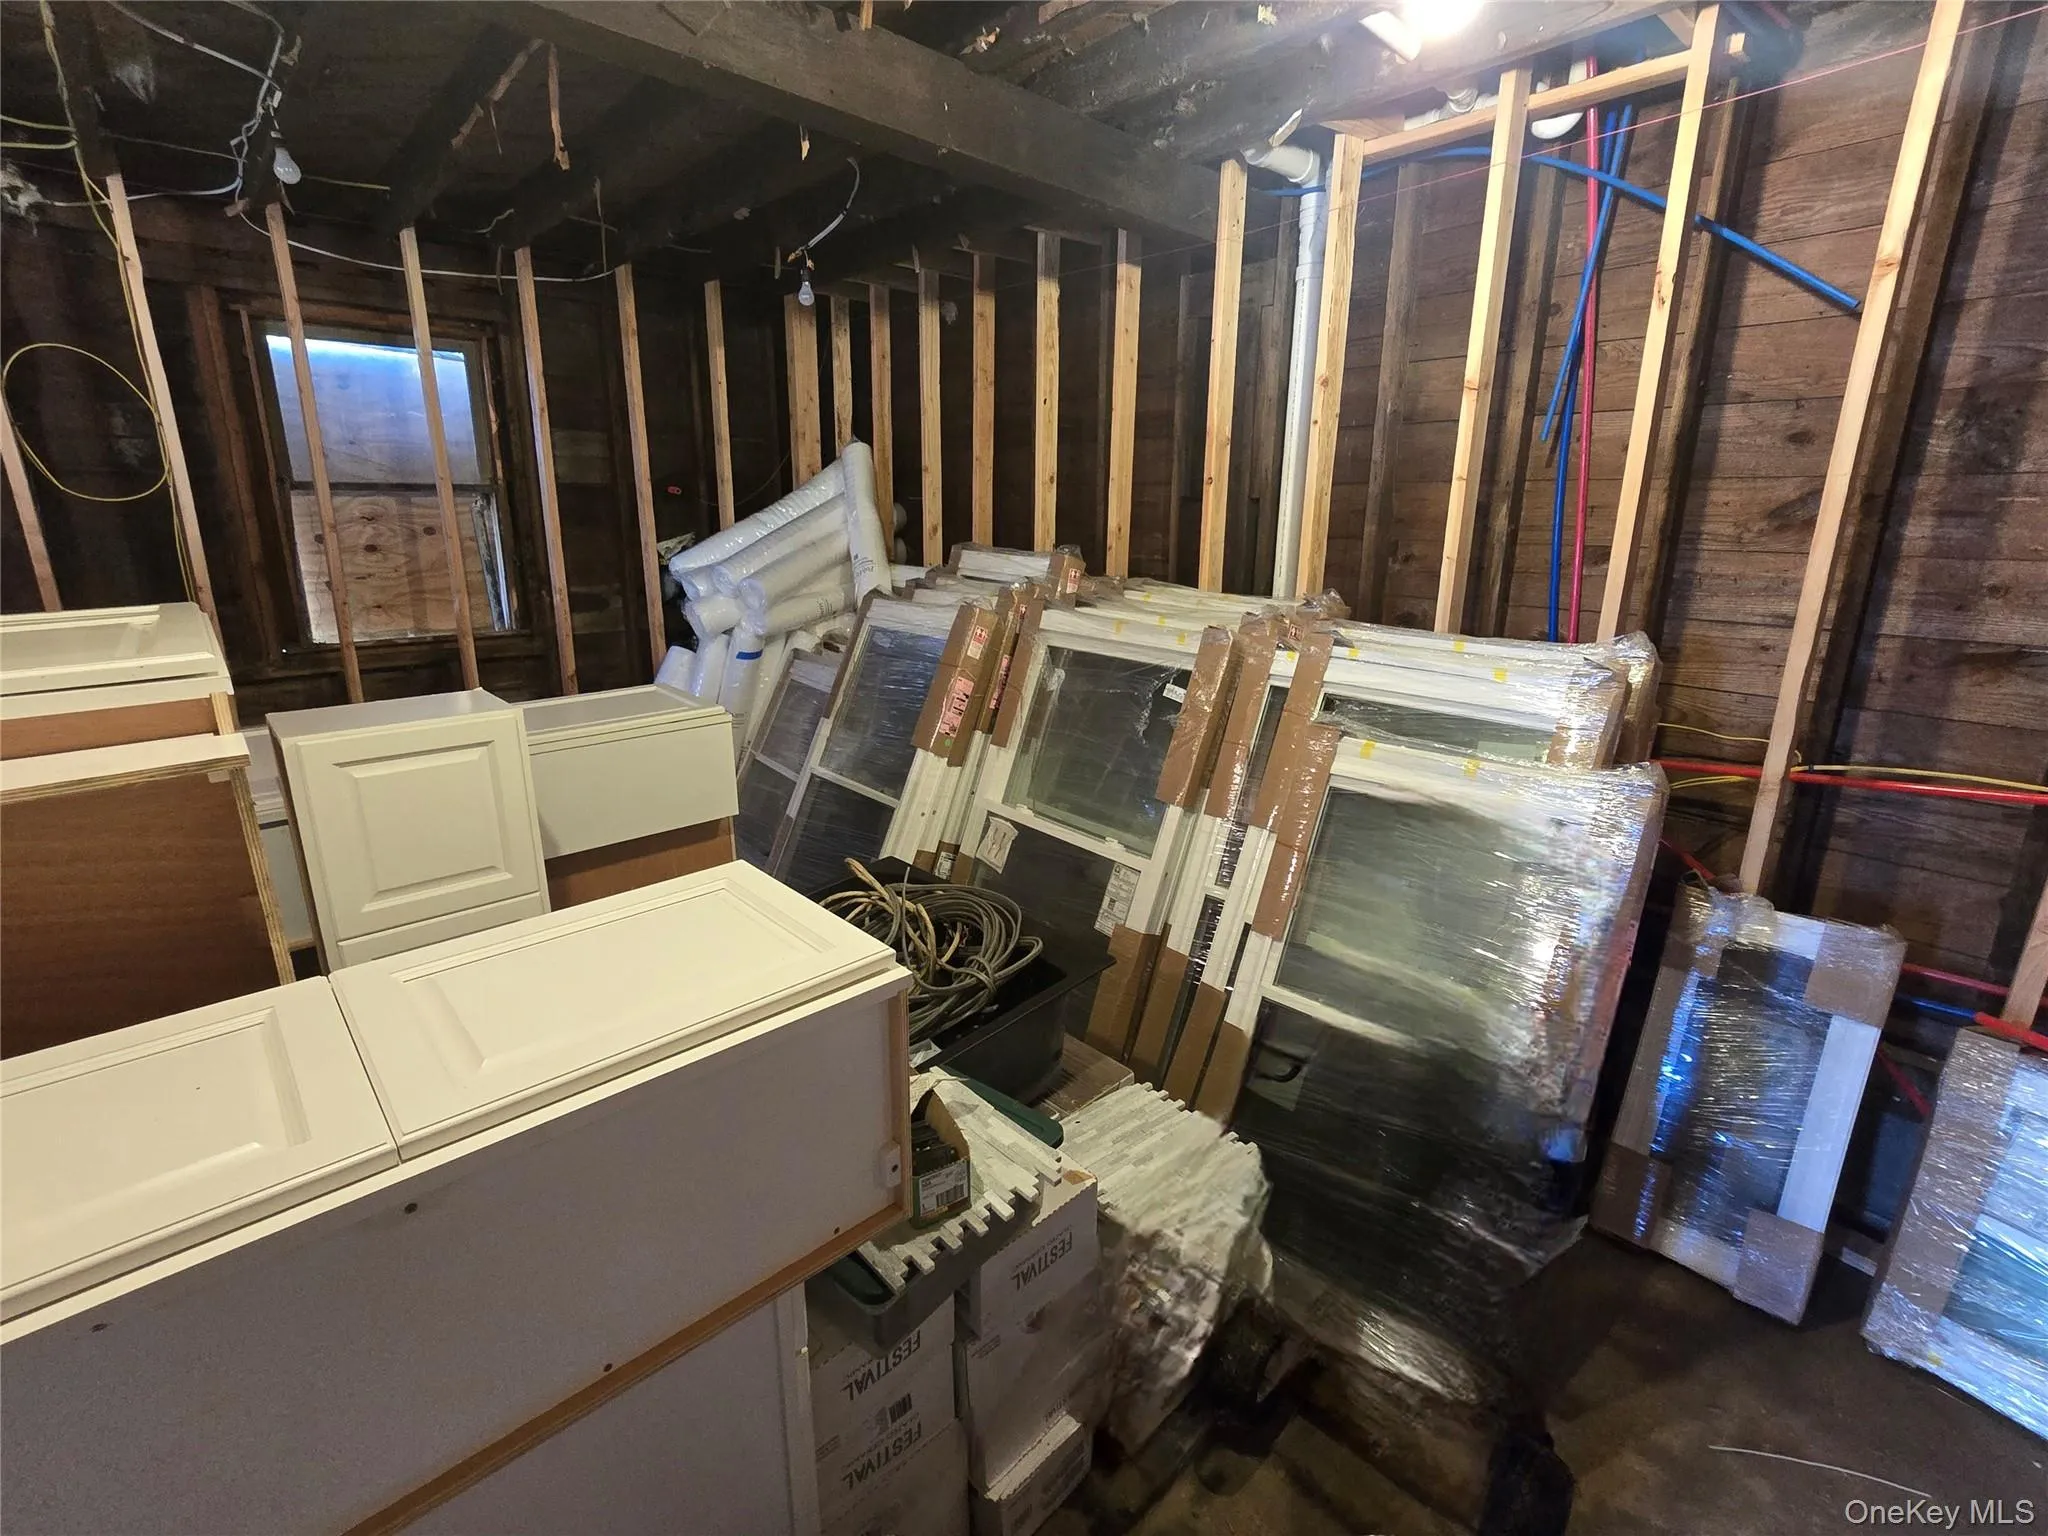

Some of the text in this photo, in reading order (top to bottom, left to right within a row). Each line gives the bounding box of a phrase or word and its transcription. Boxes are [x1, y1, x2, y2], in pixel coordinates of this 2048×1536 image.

[1010, 1231, 1073, 1291] FESTIVAL
[840, 1330, 921, 1401] FESTIVAL
[841, 1421, 922, 1490] FESTIVAL
